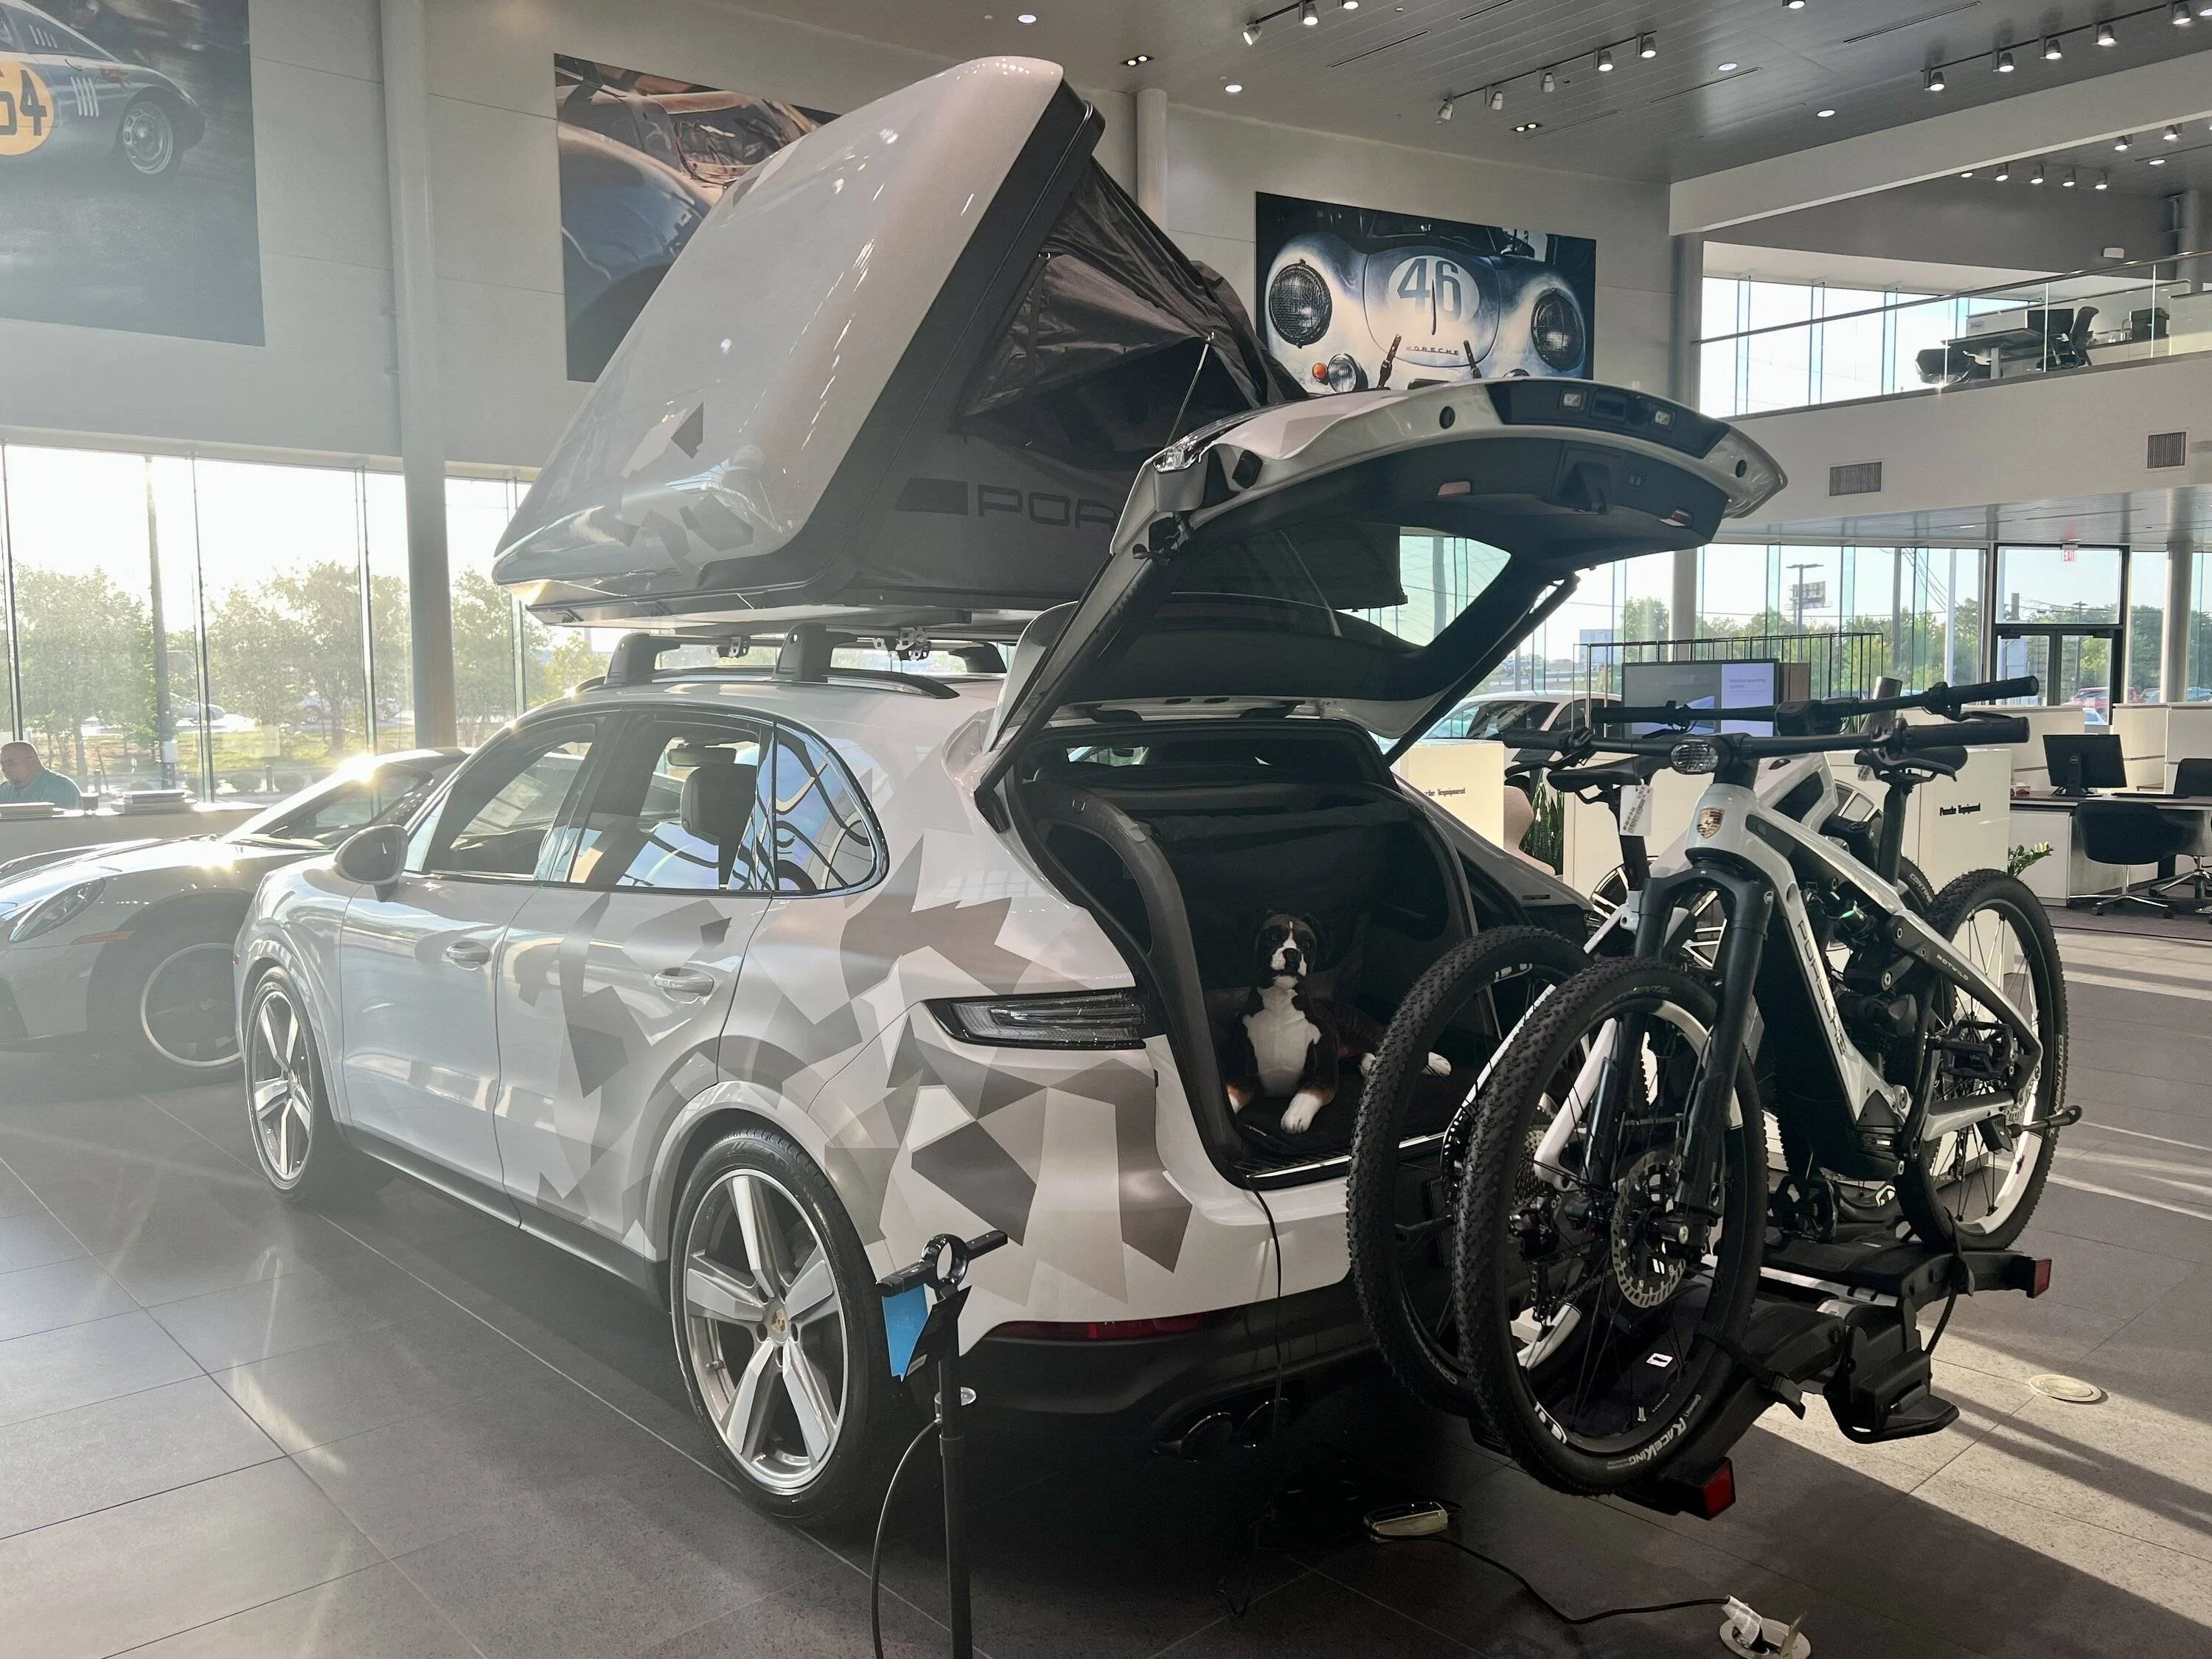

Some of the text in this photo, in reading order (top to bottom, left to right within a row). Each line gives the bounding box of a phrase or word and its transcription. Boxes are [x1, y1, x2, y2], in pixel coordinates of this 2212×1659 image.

[1397, 258, 1462, 322] 46
[1406, 345, 1460, 356] PORSCHE
[1798, 919, 1847, 1056] PORSCHE
